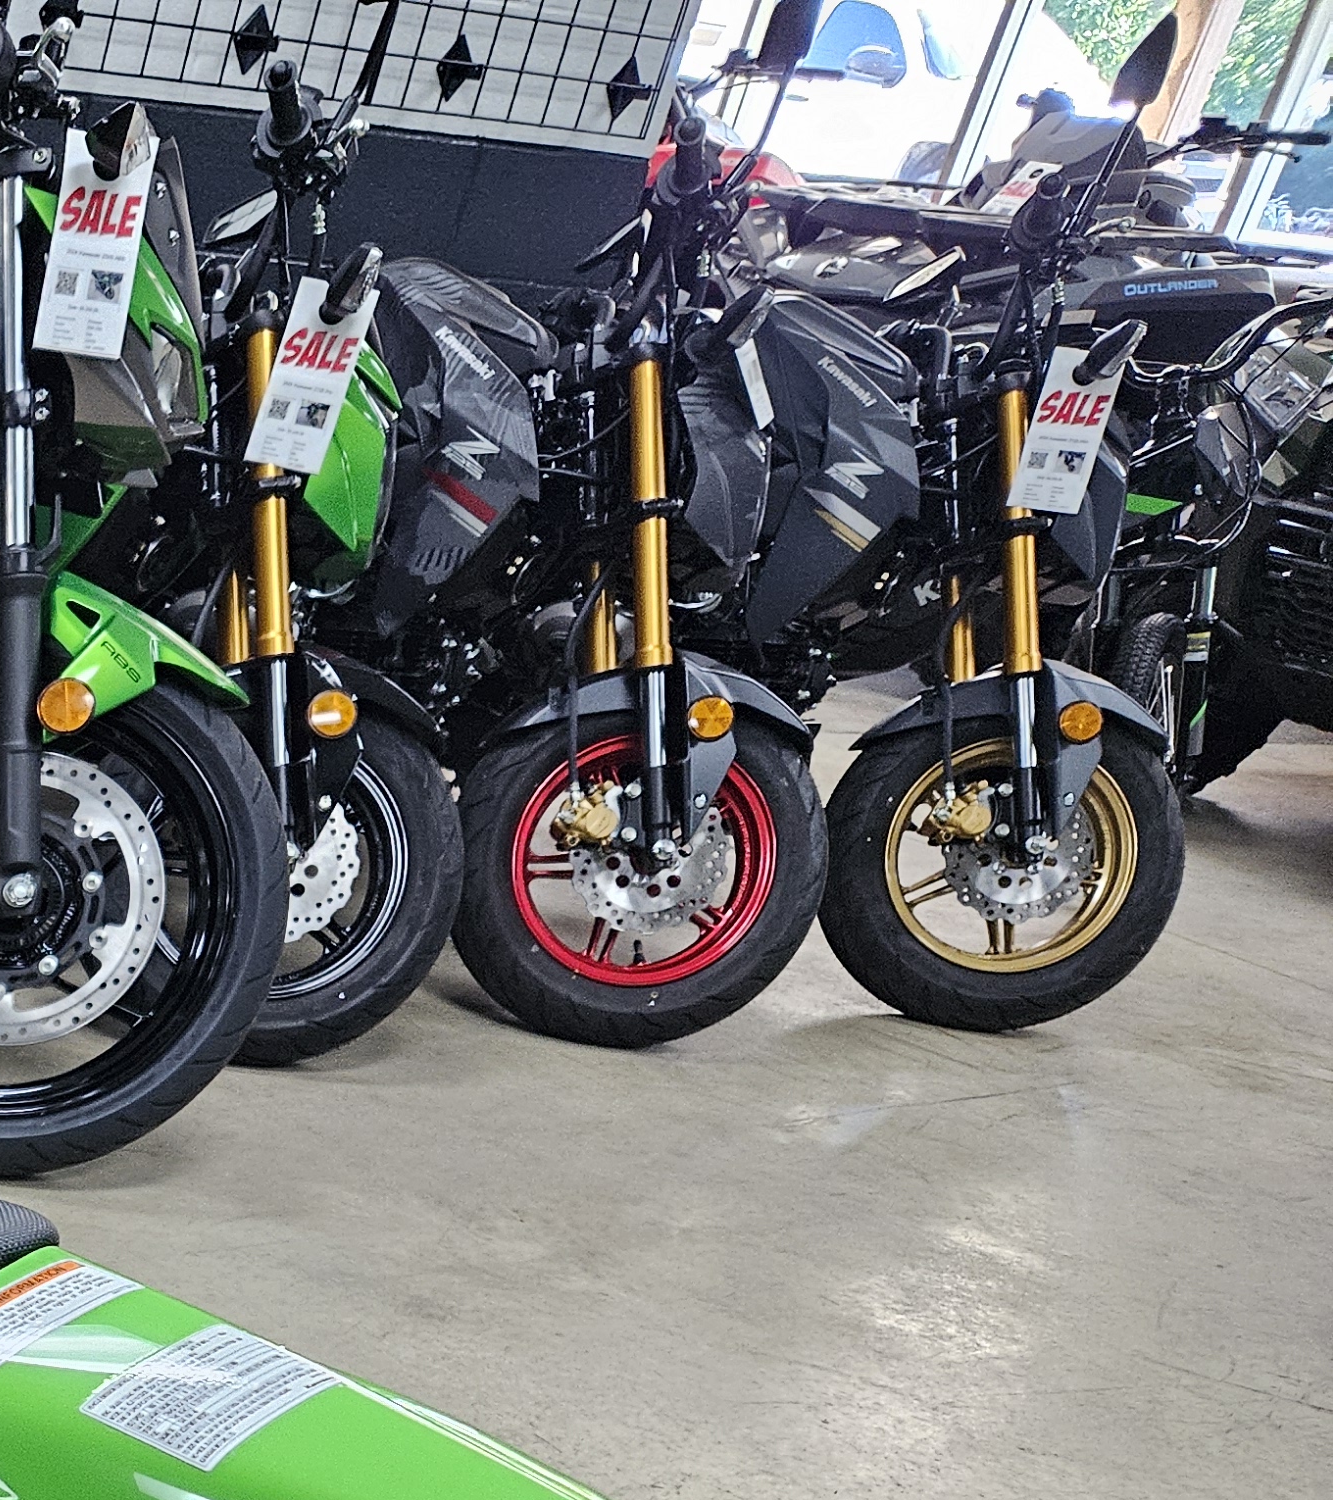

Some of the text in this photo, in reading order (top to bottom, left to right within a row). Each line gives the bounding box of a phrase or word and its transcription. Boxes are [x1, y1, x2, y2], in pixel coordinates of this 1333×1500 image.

[60, 185, 143, 239] SALE
[1123, 279, 1218, 297] OUTLANDER
[281, 328, 359, 374] SALE
[435, 325, 496, 380] Kawasaki
[817, 355, 878, 408] Kawasaki
[1037, 389, 1111, 427] SALE
[101, 641, 141, 683] ABS
